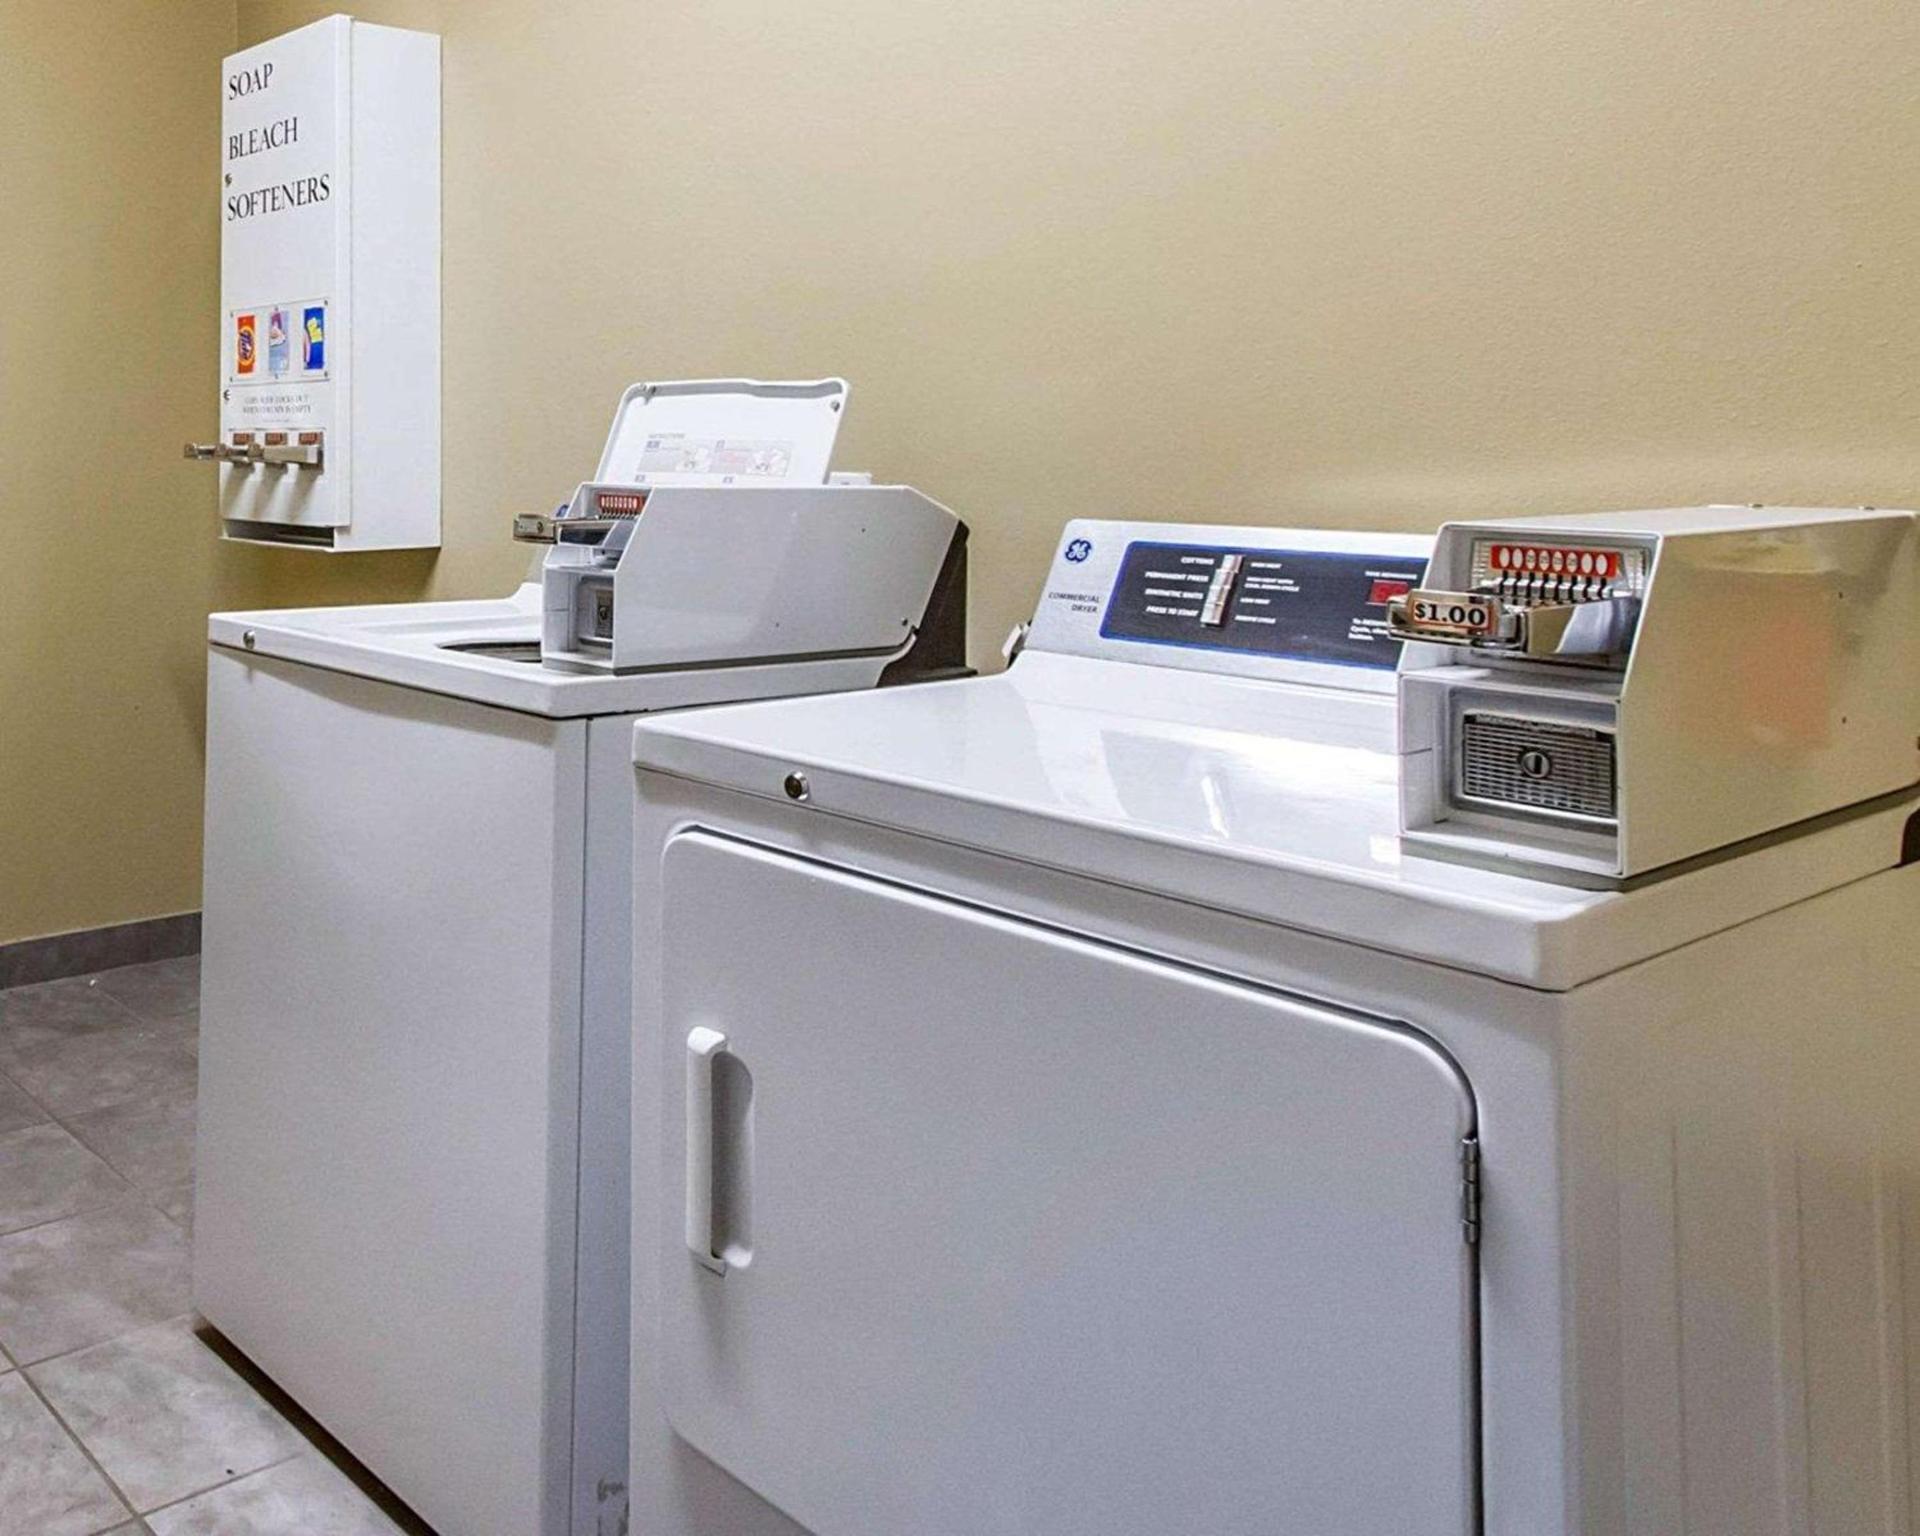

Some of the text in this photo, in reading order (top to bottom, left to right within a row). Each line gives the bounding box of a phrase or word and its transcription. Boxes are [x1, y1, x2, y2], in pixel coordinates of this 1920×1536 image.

[228, 62, 274, 100] SOAP
[228, 116, 298, 161] BLEACH
[227, 173, 331, 222] SOFTENERS
[1144, 571, 1187, 581] PERMANENT
[1048, 591, 1100, 604] COMMERCIAL
[1071, 604, 1098, 613] DRYER
[1413, 603, 1487, 626] $1.00
